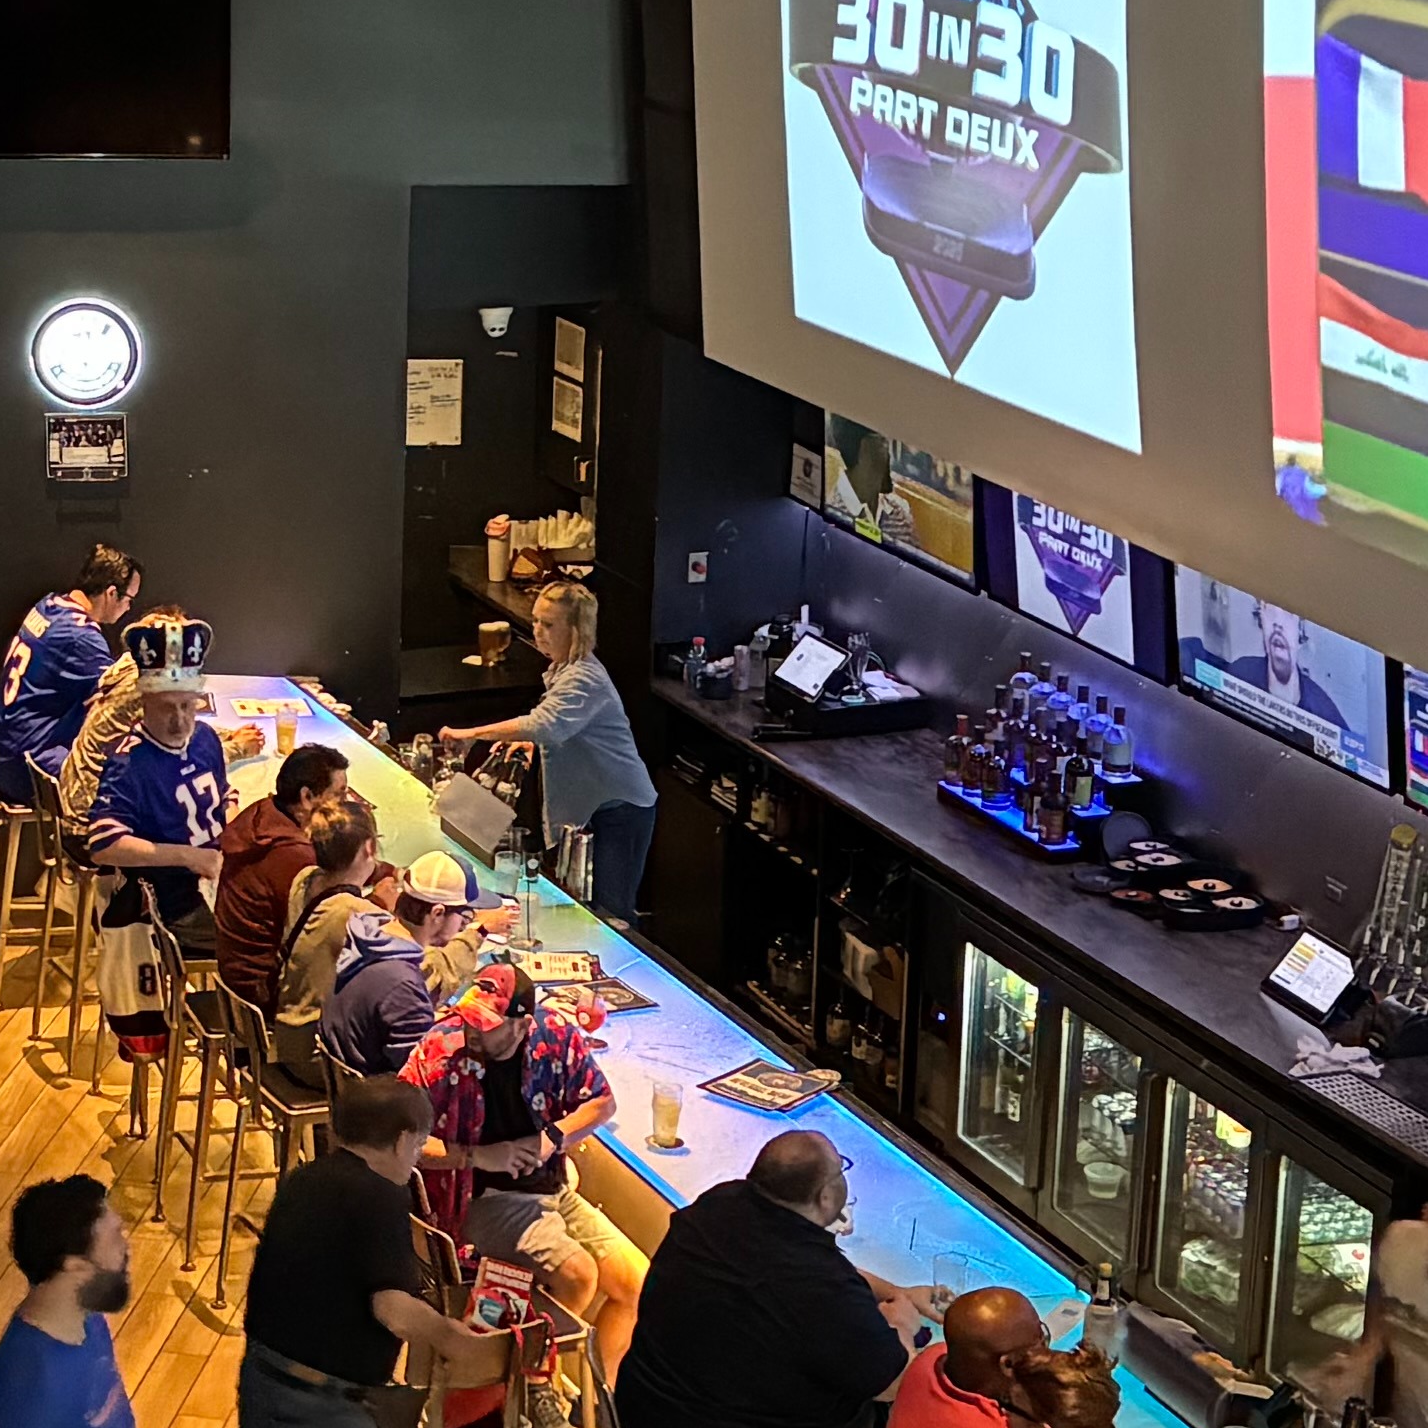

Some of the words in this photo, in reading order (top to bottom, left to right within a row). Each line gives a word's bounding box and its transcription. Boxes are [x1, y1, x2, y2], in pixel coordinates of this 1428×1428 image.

[926, 10, 972, 69] IN
[849, 75, 939, 143] PART
[944, 107, 1040, 172] DEUX
[1037, 530, 1070, 560] PART
[1070, 545, 1104, 573] DEUX
[175, 771, 224, 847] 17
